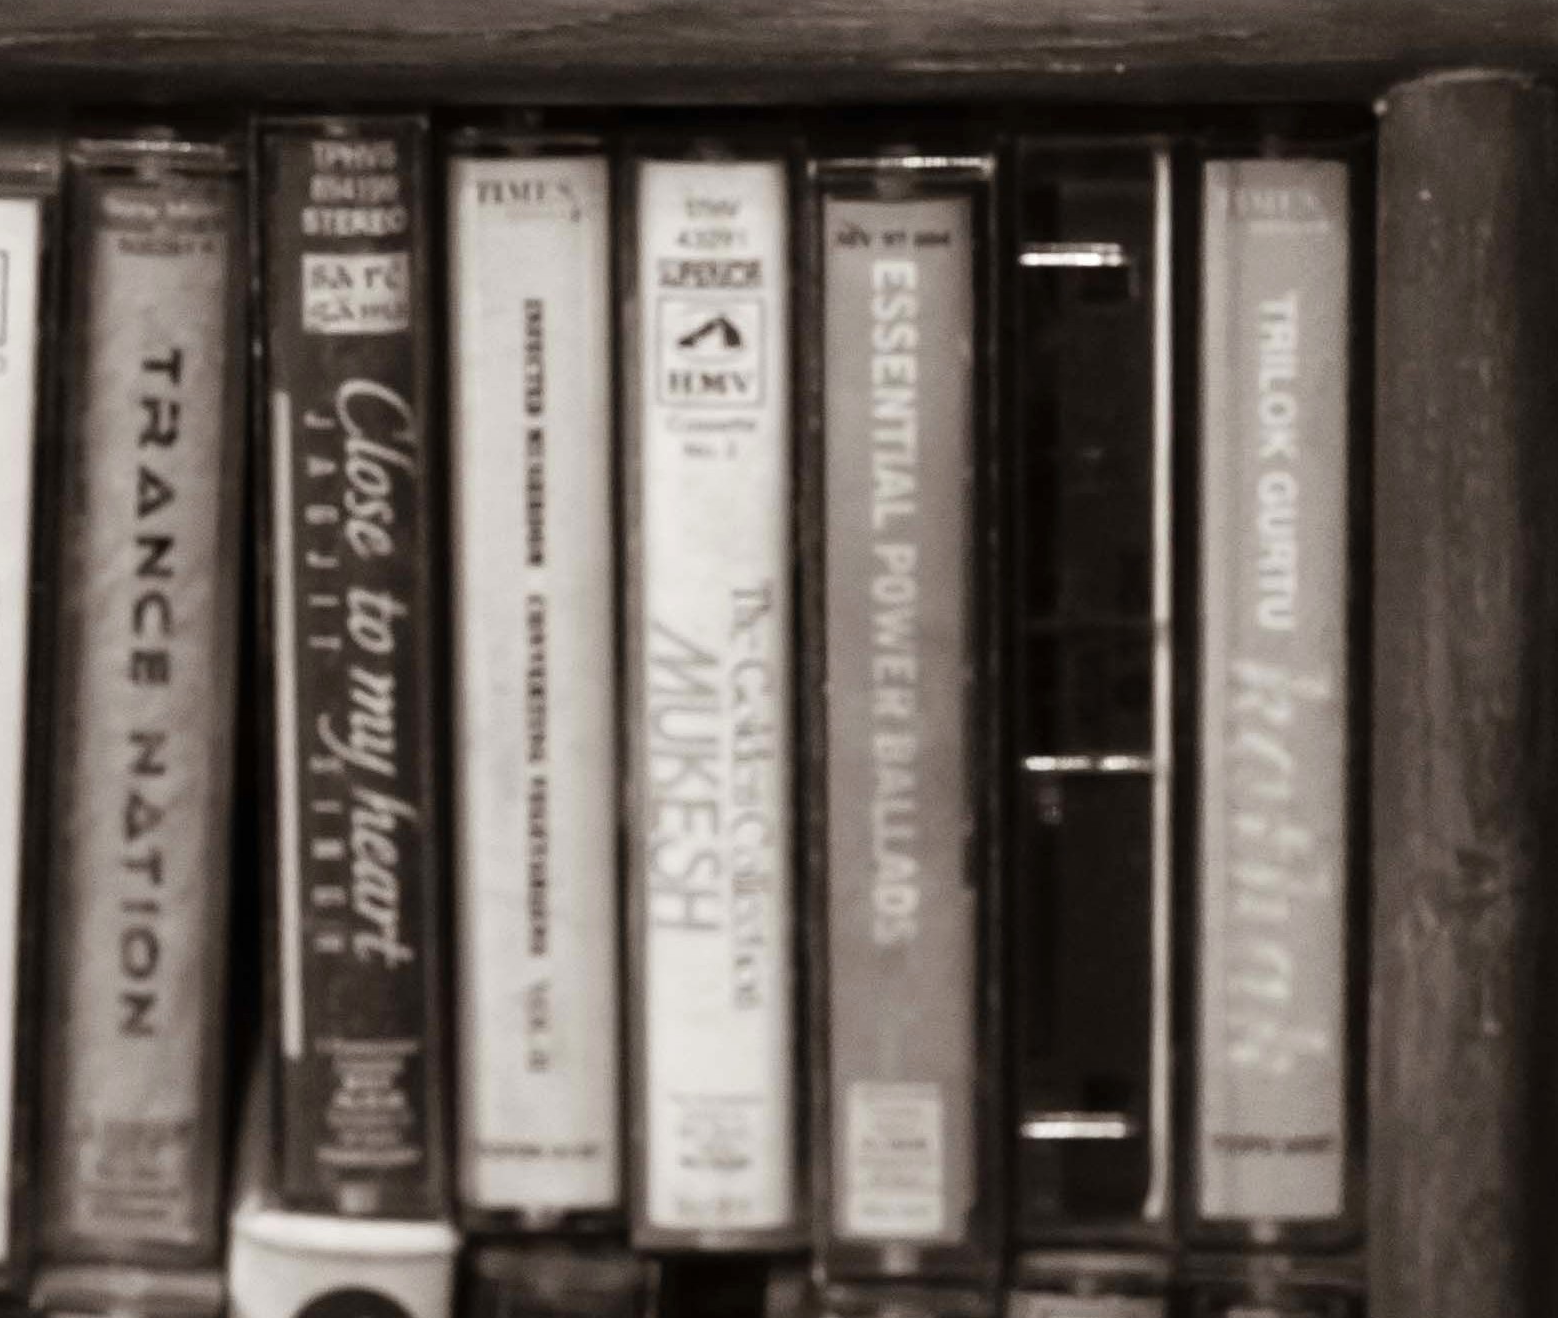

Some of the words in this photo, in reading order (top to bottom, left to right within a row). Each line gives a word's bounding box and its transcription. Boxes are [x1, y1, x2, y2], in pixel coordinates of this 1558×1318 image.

[871, 260, 918, 530] ESSENTIAL
[1258, 291, 1299, 464] TRILOK
[128, 348, 183, 689] TRANCE
[336, 379, 418, 558] Close
[1258, 470, 1298, 633] GURTU
[347, 588, 408, 653] to
[873, 542, 920, 716] POWER
[319, 666, 396, 776] my
[649, 619, 721, 933] MUKESH
[118, 728, 167, 1040] NATION
[349, 787, 419, 969] heart
[872, 733, 920, 946] BALLADS
